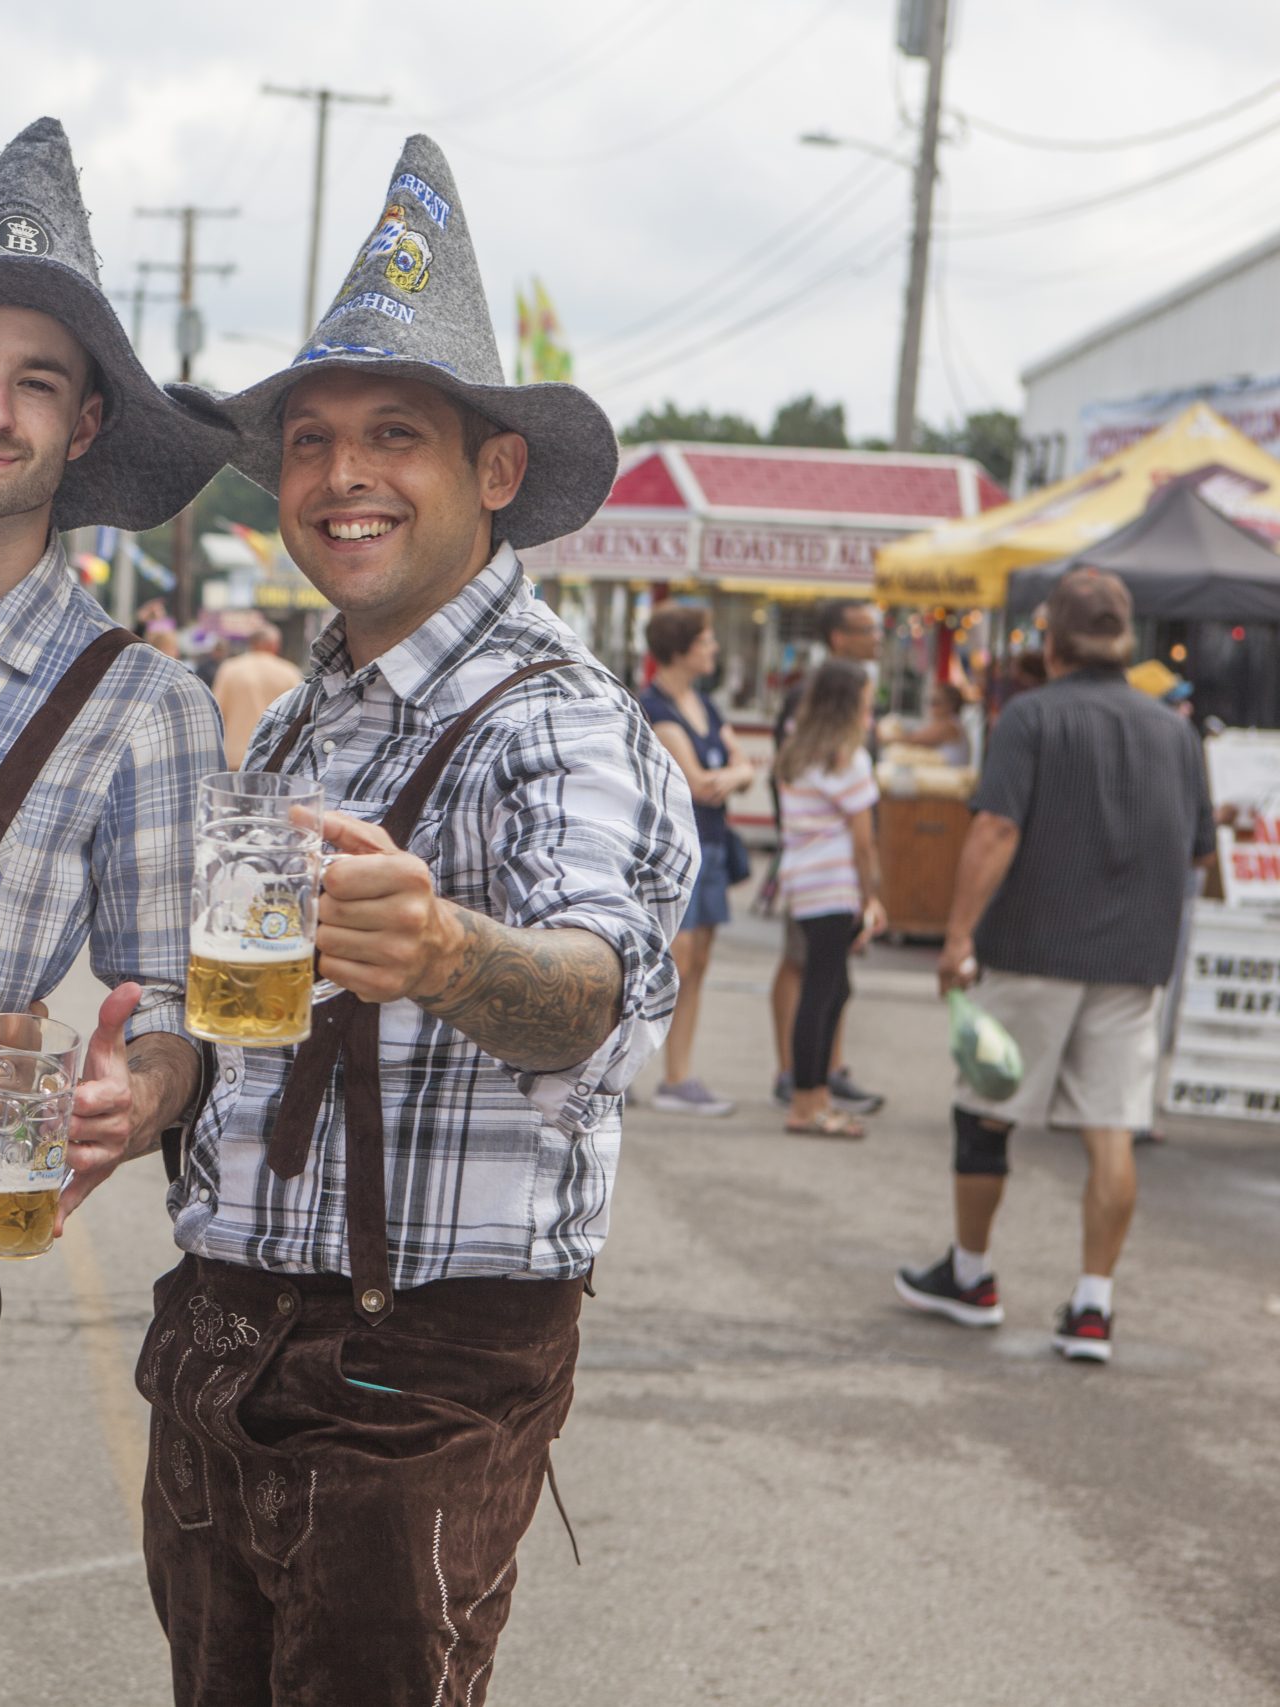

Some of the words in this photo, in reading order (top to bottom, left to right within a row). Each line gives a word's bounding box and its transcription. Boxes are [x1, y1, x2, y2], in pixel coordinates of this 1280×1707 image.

[5, 233, 38, 252] HB
[1196, 953, 1280, 983] SMOO
[1217, 989, 1280, 1014] WAF
